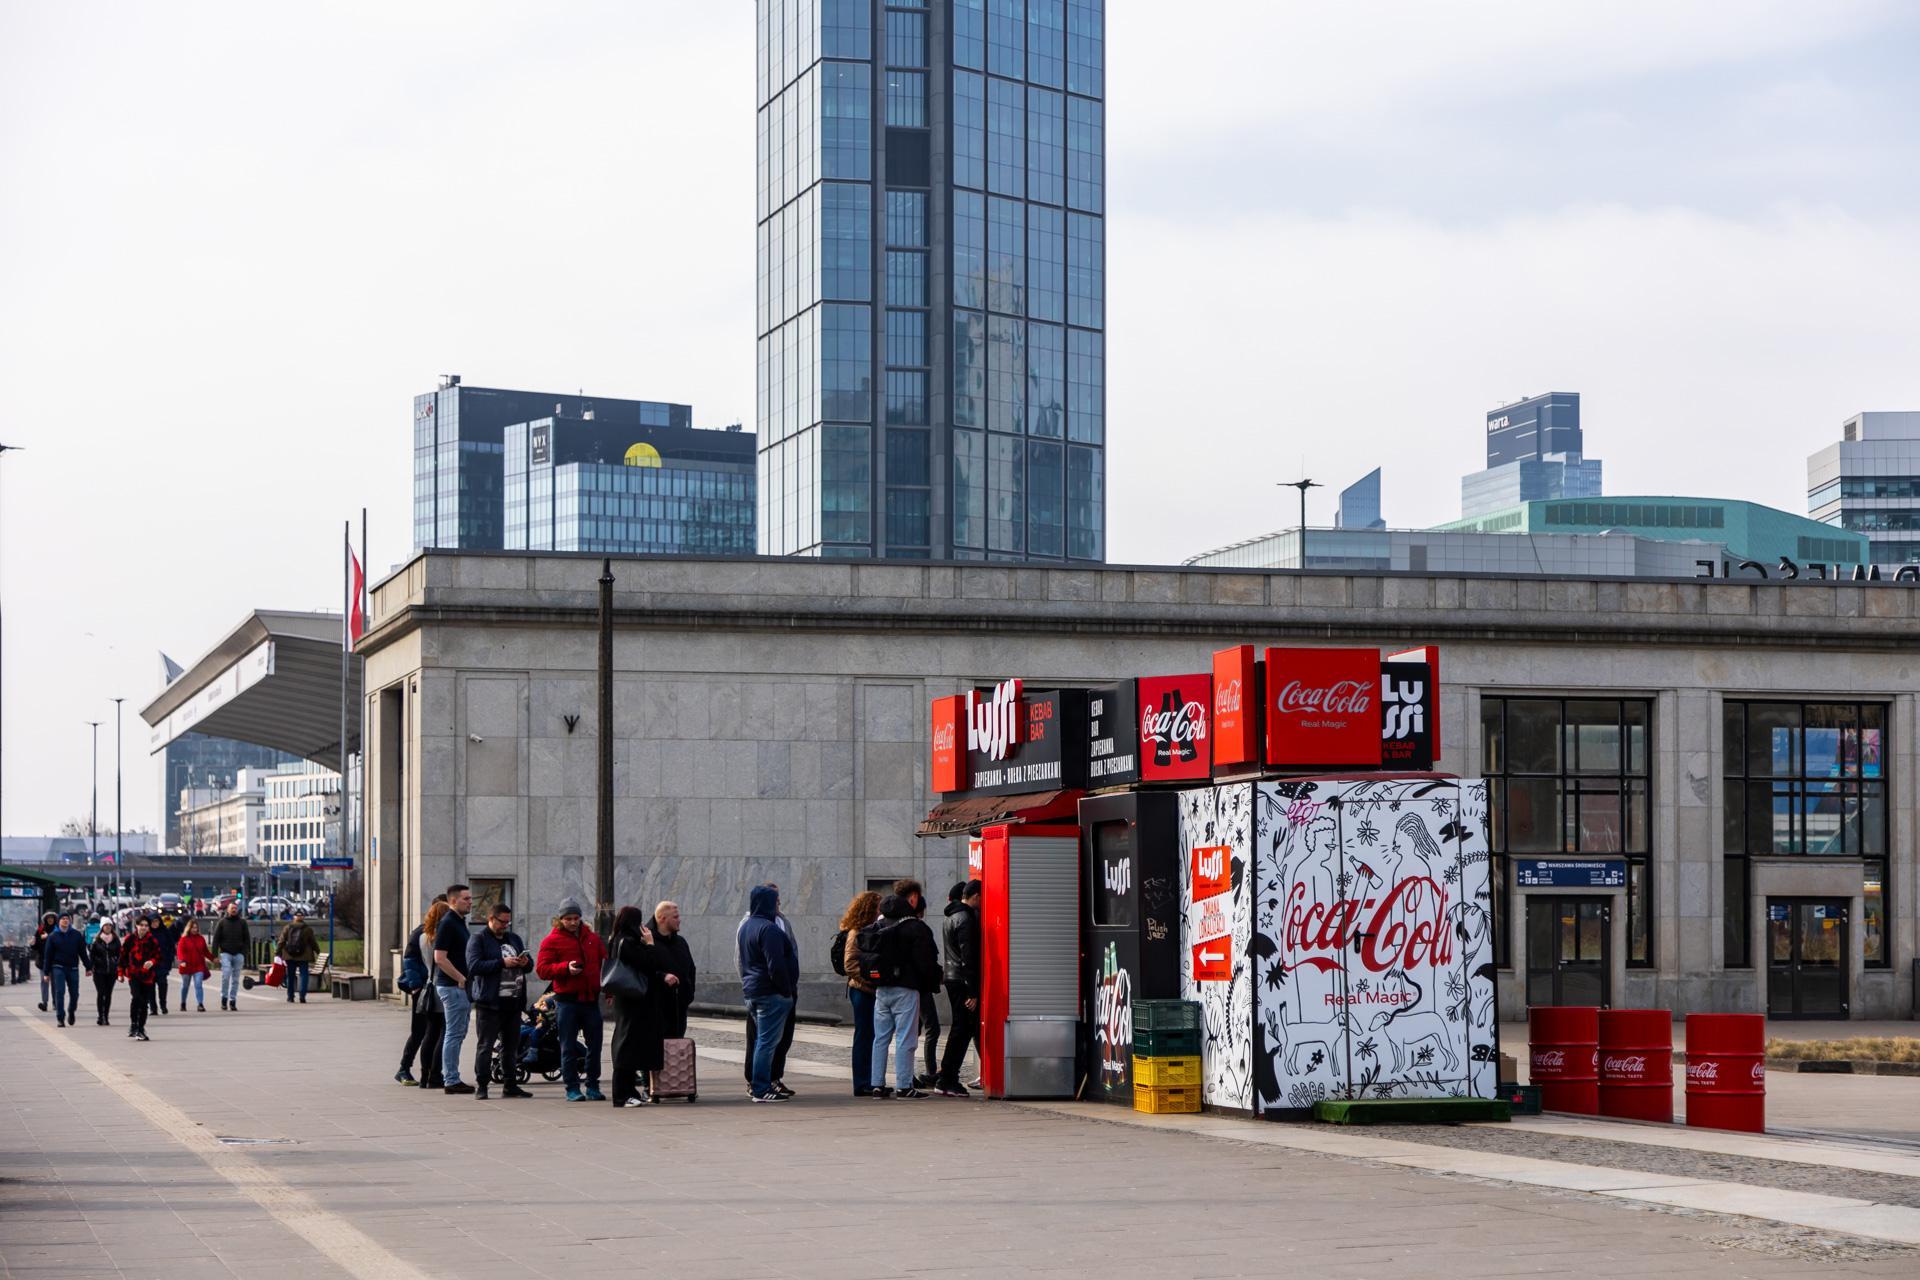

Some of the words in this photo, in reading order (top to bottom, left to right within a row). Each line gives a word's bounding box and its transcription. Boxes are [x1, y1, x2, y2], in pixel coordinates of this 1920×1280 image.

[533, 435, 546, 448] NYX
[1277, 680, 1374, 713] Coca-Cola
[1030, 701, 1053, 722] KEBAB
[1091, 699, 1103, 717] KEBAB
[1030, 722, 1045, 741] BAR
[1091, 720, 1099, 738] BAR
[1301, 720, 1320, 728] Real
[1322, 720, 1347, 728] Magic
[1091, 737, 1114, 758] ZAPIEKANKA
[1172, 748, 1190, 756] Magic
[975, 769, 1002, 788] ZAPIEKANKA
[1027, 761, 1061, 782] PIECZARKAMI
[1601, 870, 1606, 878] 3
[1281, 876, 1453, 974] Coca-Cola
[1324, 991, 1362, 1006] Real
[1365, 990, 1412, 1006] Magic
[1604, 1056, 1647, 1072] Coca-Cola
